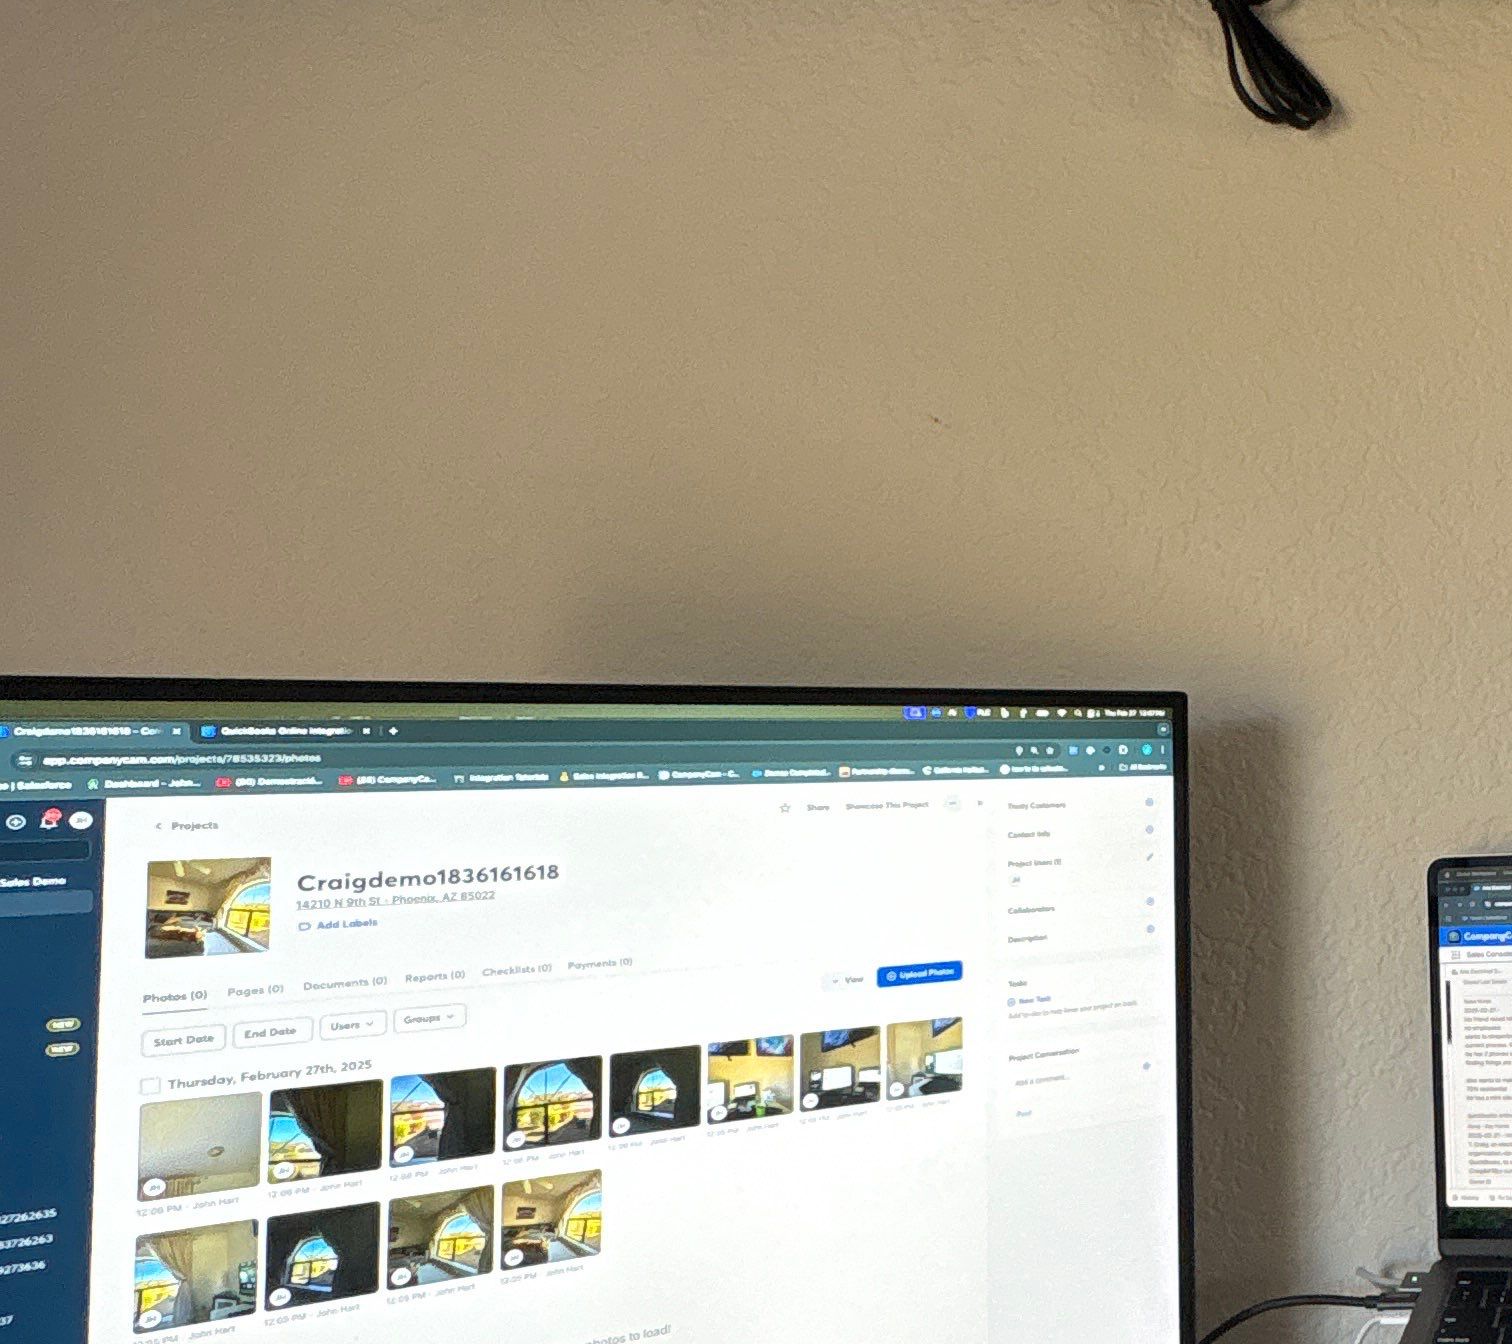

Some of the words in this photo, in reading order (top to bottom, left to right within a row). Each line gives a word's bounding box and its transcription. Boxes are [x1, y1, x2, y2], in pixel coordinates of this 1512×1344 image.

[172, 821, 219, 831] Projects
[297, 864, 560, 894] Craigdemo1836161618
[317, 920, 340, 930] Add
[343, 917, 378, 929] Labels
[482, 965, 536, 977] Checklists
[568, 959, 617, 971] Payments
[405, 972, 448, 984] Reports
[303, 978, 369, 991] Documents
[142, 992, 187, 1004] Photos
[227, 986, 265, 998] Pages
[404, 1014, 441, 1025] Groups
[330, 1020, 360, 1032] Users
[244, 1029, 266, 1040] End
[270, 1026, 297, 1037] Date
[153, 1036, 183, 1047] Start
[186, 1033, 215, 1045] Date
[168, 1074, 237, 1090] Thursday,
[240, 1067, 302, 1083] February
[305, 1063, 337, 1076] 27th,
[341, 1059, 373, 1072] 2025
[629, 1332, 640, 1341] to
